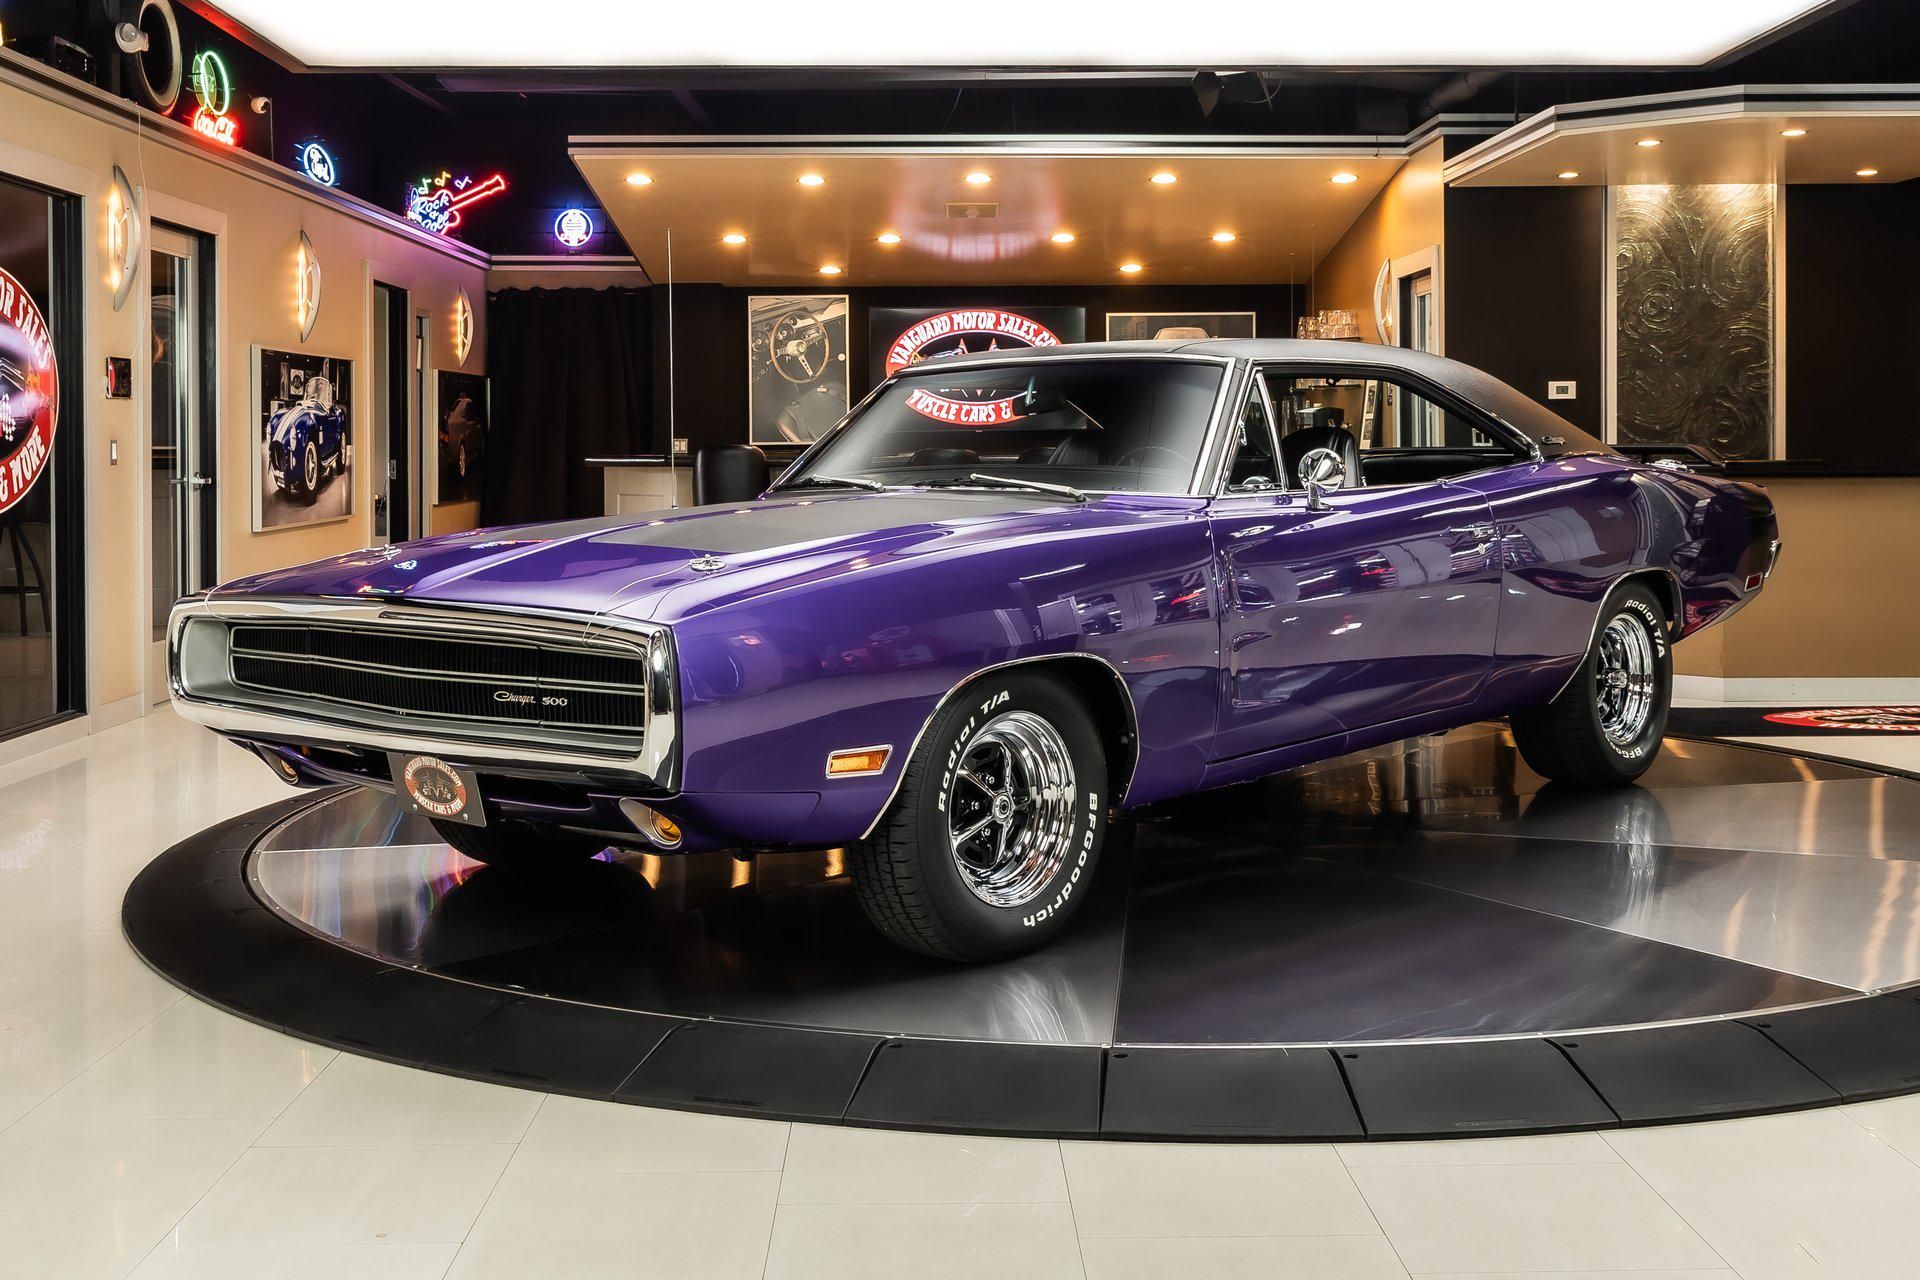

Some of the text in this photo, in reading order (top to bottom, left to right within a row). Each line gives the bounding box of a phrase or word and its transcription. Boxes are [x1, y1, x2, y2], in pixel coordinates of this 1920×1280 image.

[418, 191, 450, 214] Rock
[15, 294, 53, 370] SALES
[889, 311, 1057, 366] VANGUARD MOTOR SALES.CO
[959, 403, 997, 423] CARS
[999, 401, 1012, 420] &
[9, 424, 46, 495] MORE
[1624, 599, 1666, 659] Radial T/A
[493, 690, 568, 707] Charger 500
[938, 689, 1011, 813] Radial T/A
[1022, 792, 1099, 928] BFGoodrich
